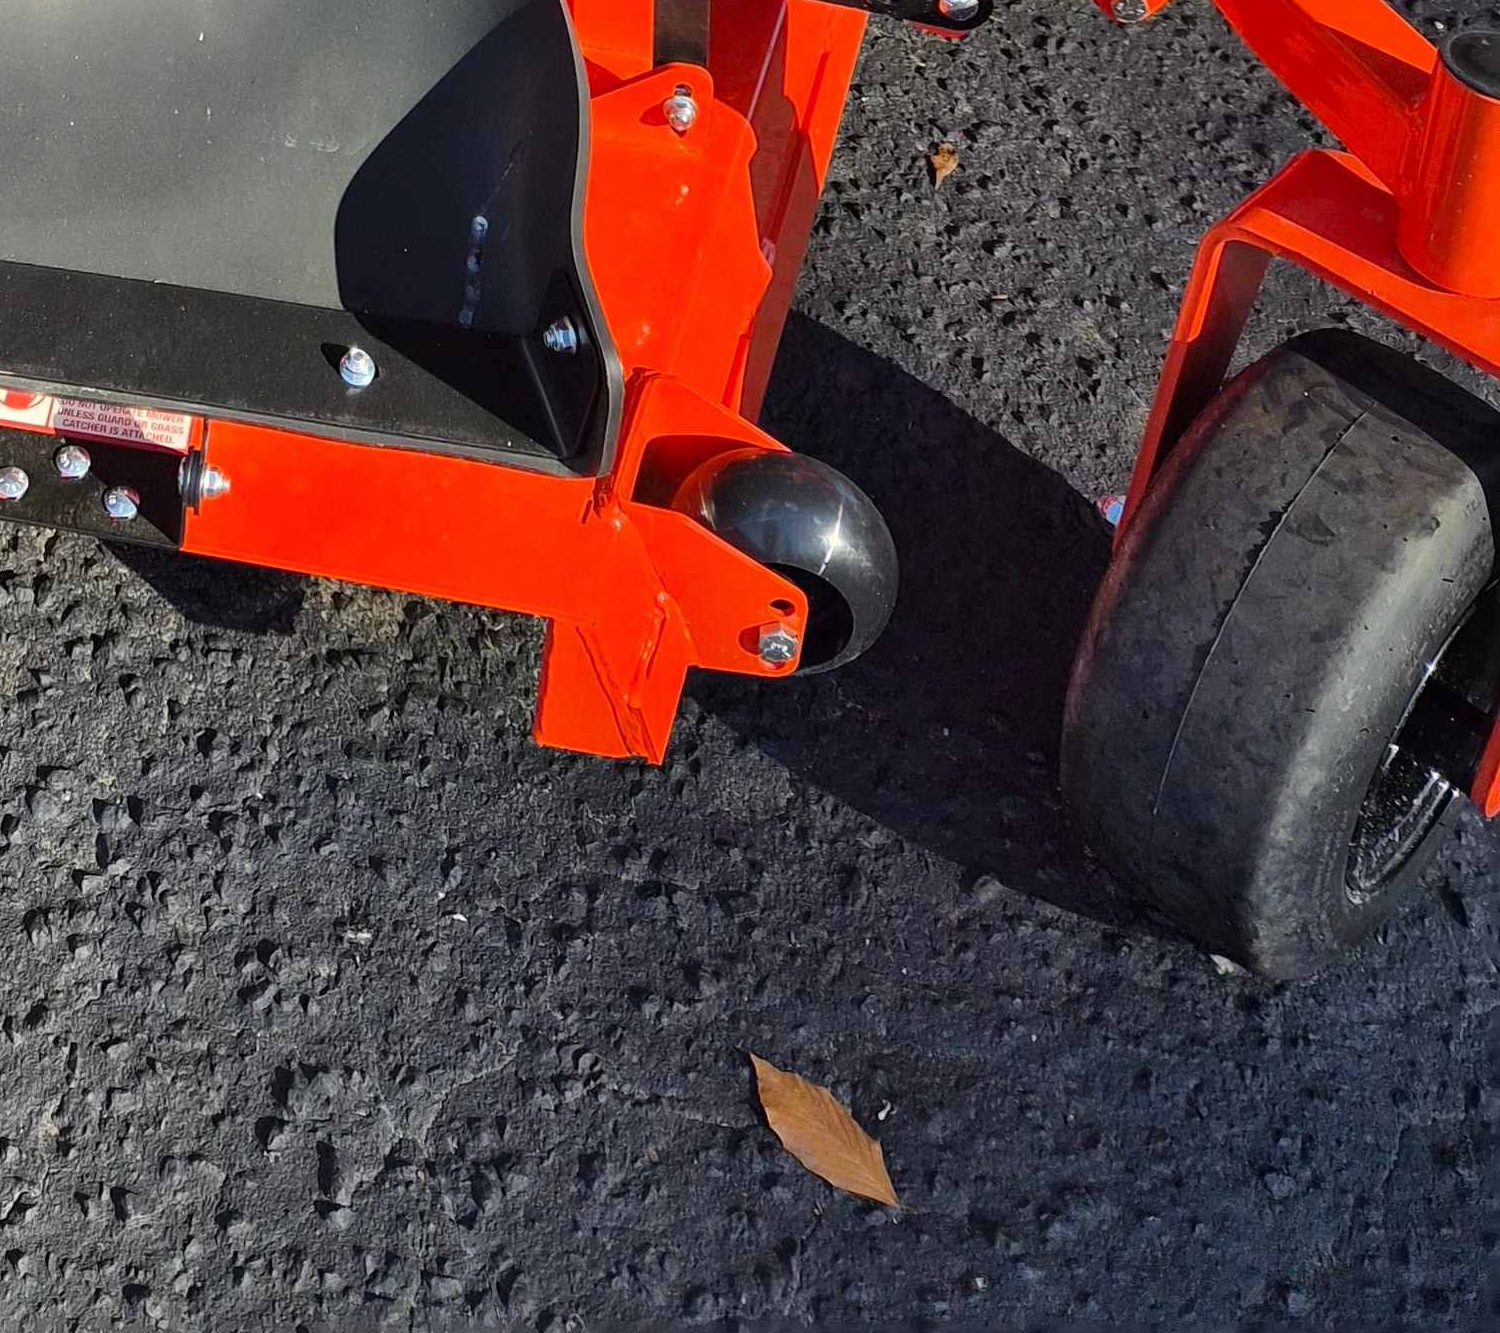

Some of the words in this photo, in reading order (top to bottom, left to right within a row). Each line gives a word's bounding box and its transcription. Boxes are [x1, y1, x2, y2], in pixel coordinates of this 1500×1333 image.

[58, 407, 95, 421] UNLESS
[98, 413, 132, 426] GUARD
[133, 420, 148, 429] OR
[150, 421, 185, 435] GRASS
[61, 399, 76, 407] DO
[77, 401, 97, 410] NOT
[99, 403, 144, 418] OPERATE
[146, 409, 185, 424] MOWER
[62, 418, 107, 433] CATCHER
[109, 426, 120, 436] IS
[120, 428, 176, 445] ATTACHED.
